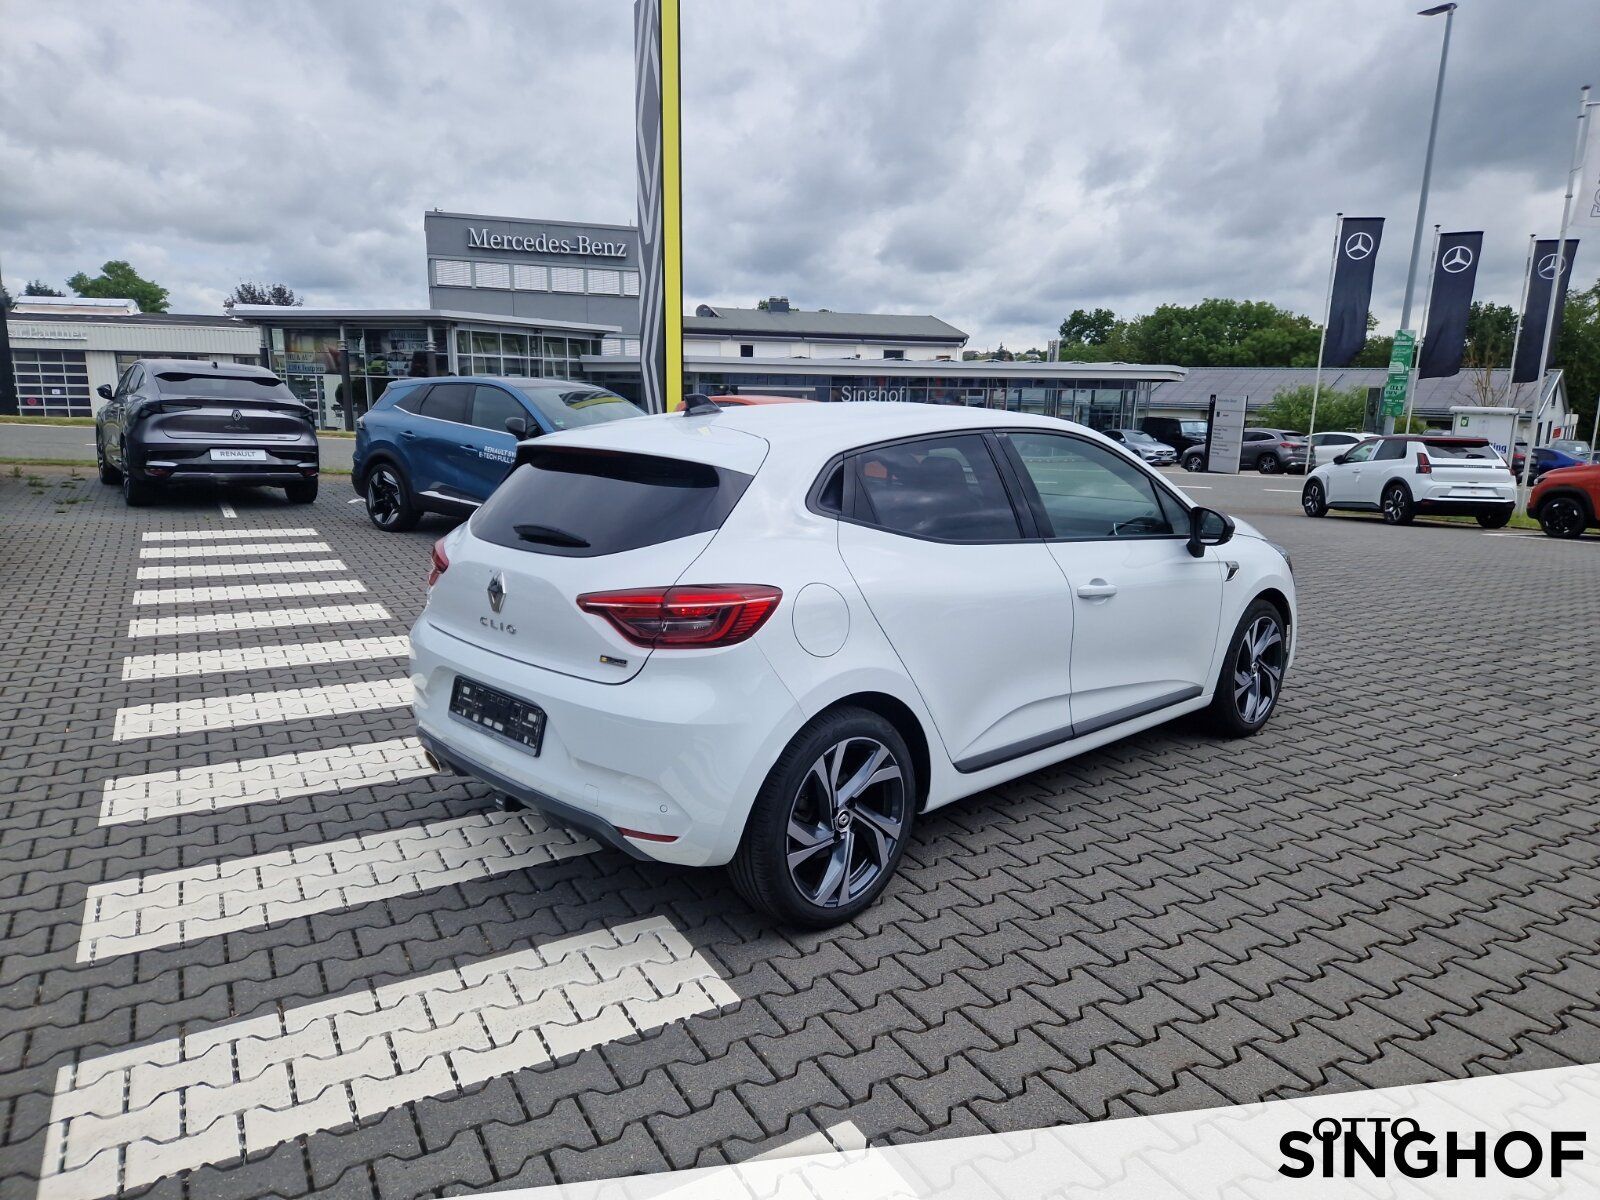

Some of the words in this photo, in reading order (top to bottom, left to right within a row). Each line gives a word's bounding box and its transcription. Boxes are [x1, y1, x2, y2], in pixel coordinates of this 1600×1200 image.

[467, 227, 627, 257] Mercedes-Benz
[841, 385, 905, 402] Singhof
[219, 450, 257, 458] RENAULT
[484, 445, 508, 455] RENAULT
[479, 616, 517, 635] CLIO
